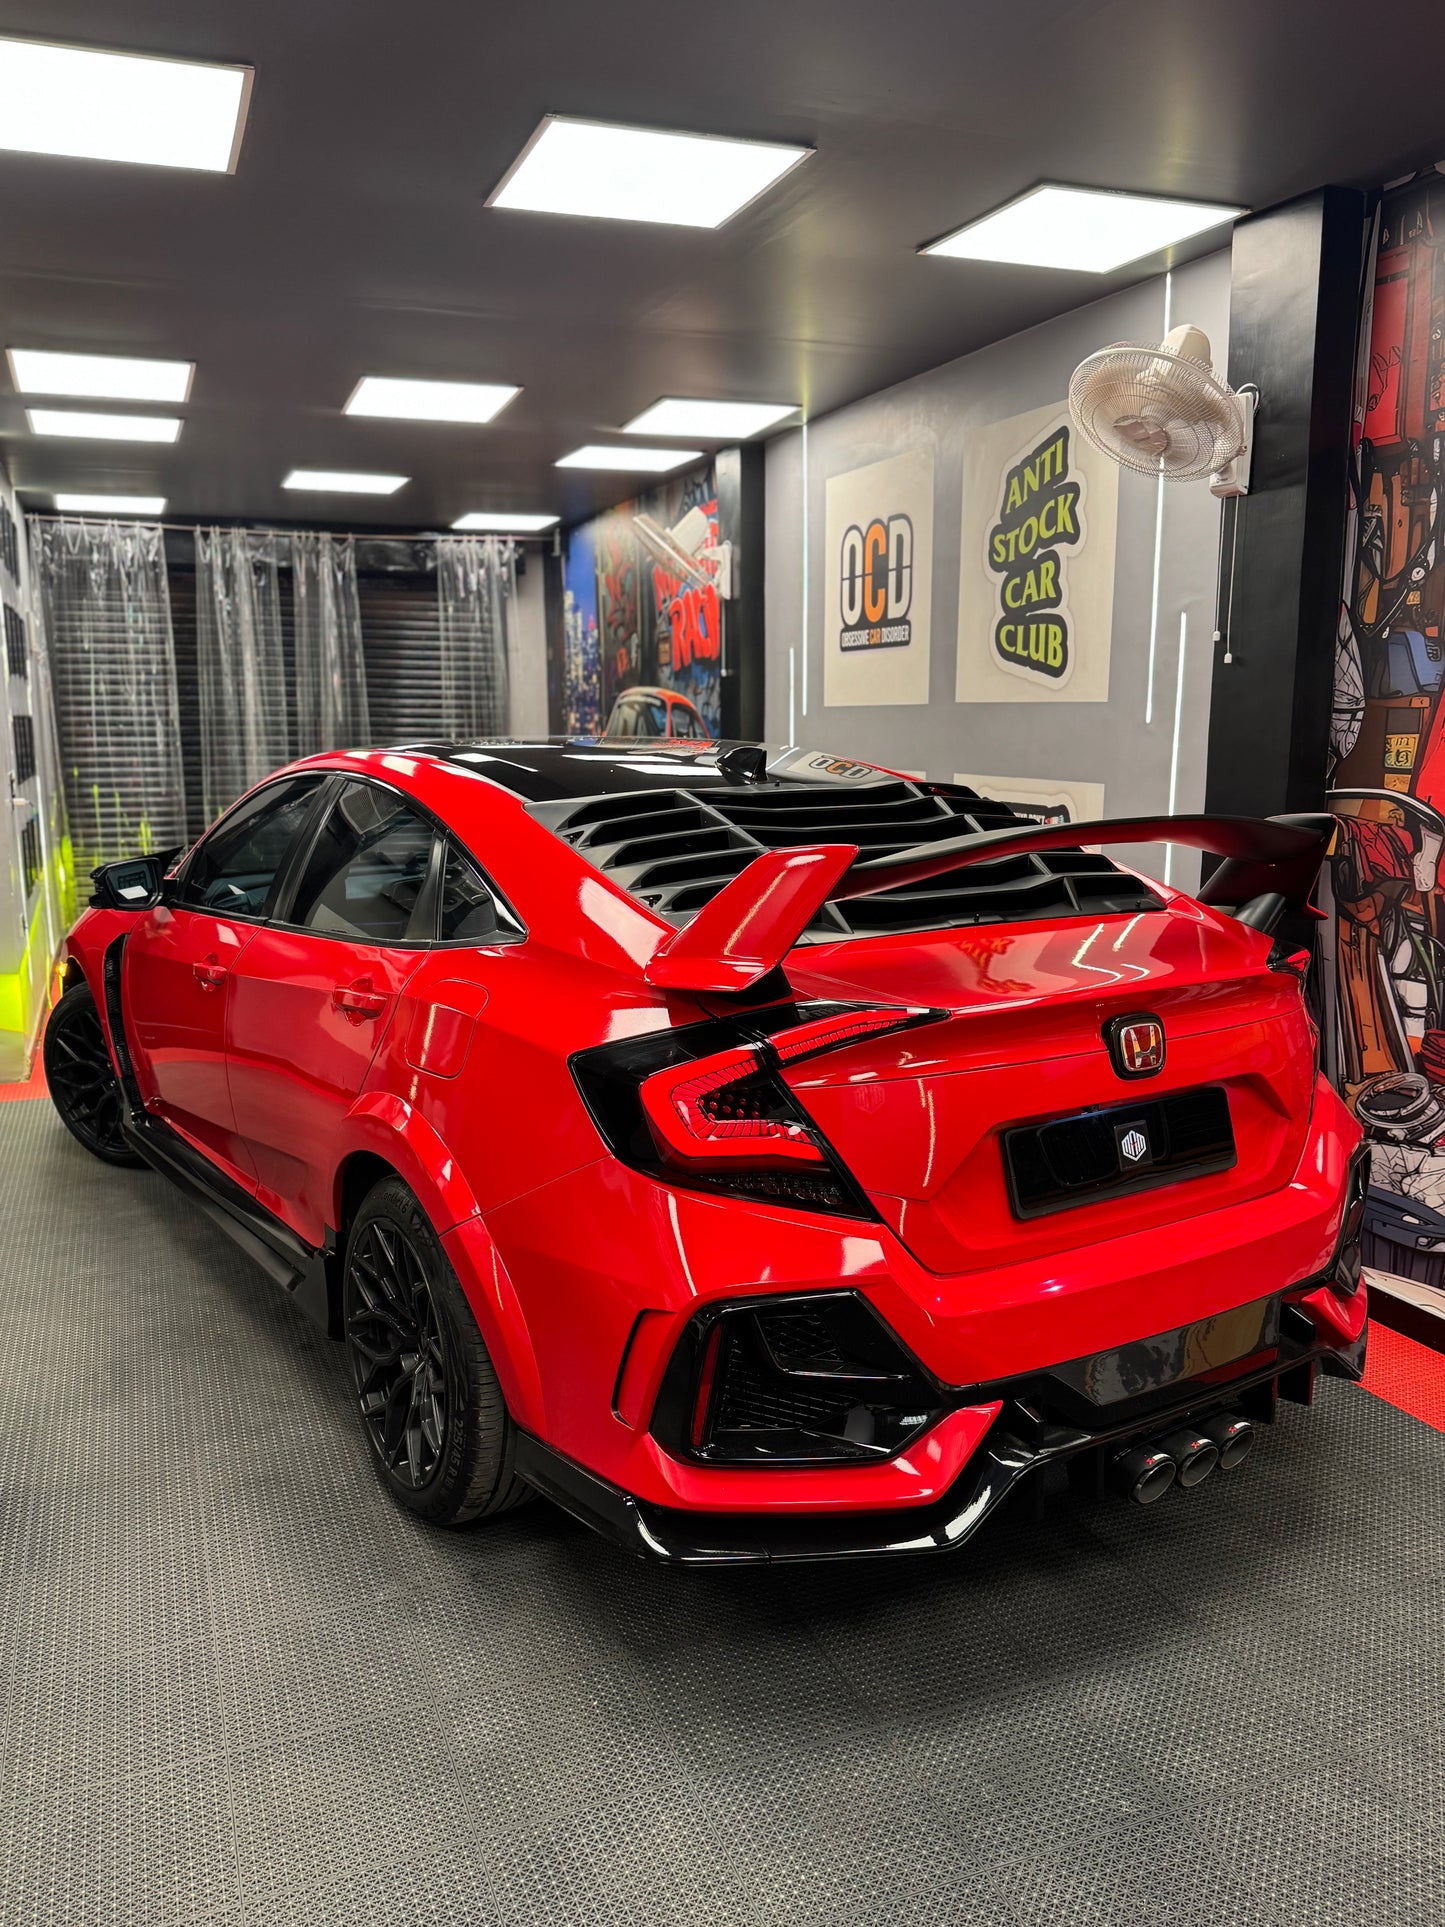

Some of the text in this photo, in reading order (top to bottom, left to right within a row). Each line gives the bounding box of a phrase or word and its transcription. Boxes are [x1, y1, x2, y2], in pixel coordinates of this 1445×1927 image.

[1005, 439, 1063, 514] ANTI
[993, 493, 1075, 563] STOCK
[841, 516, 912, 626] OCD
[1005, 559, 1057, 609] CAR
[842, 625, 910, 647] OBSESSIVE CAR DISORDER
[999, 623, 1063, 669] CLUB
[452, 1418, 464, 1466] 225/45
